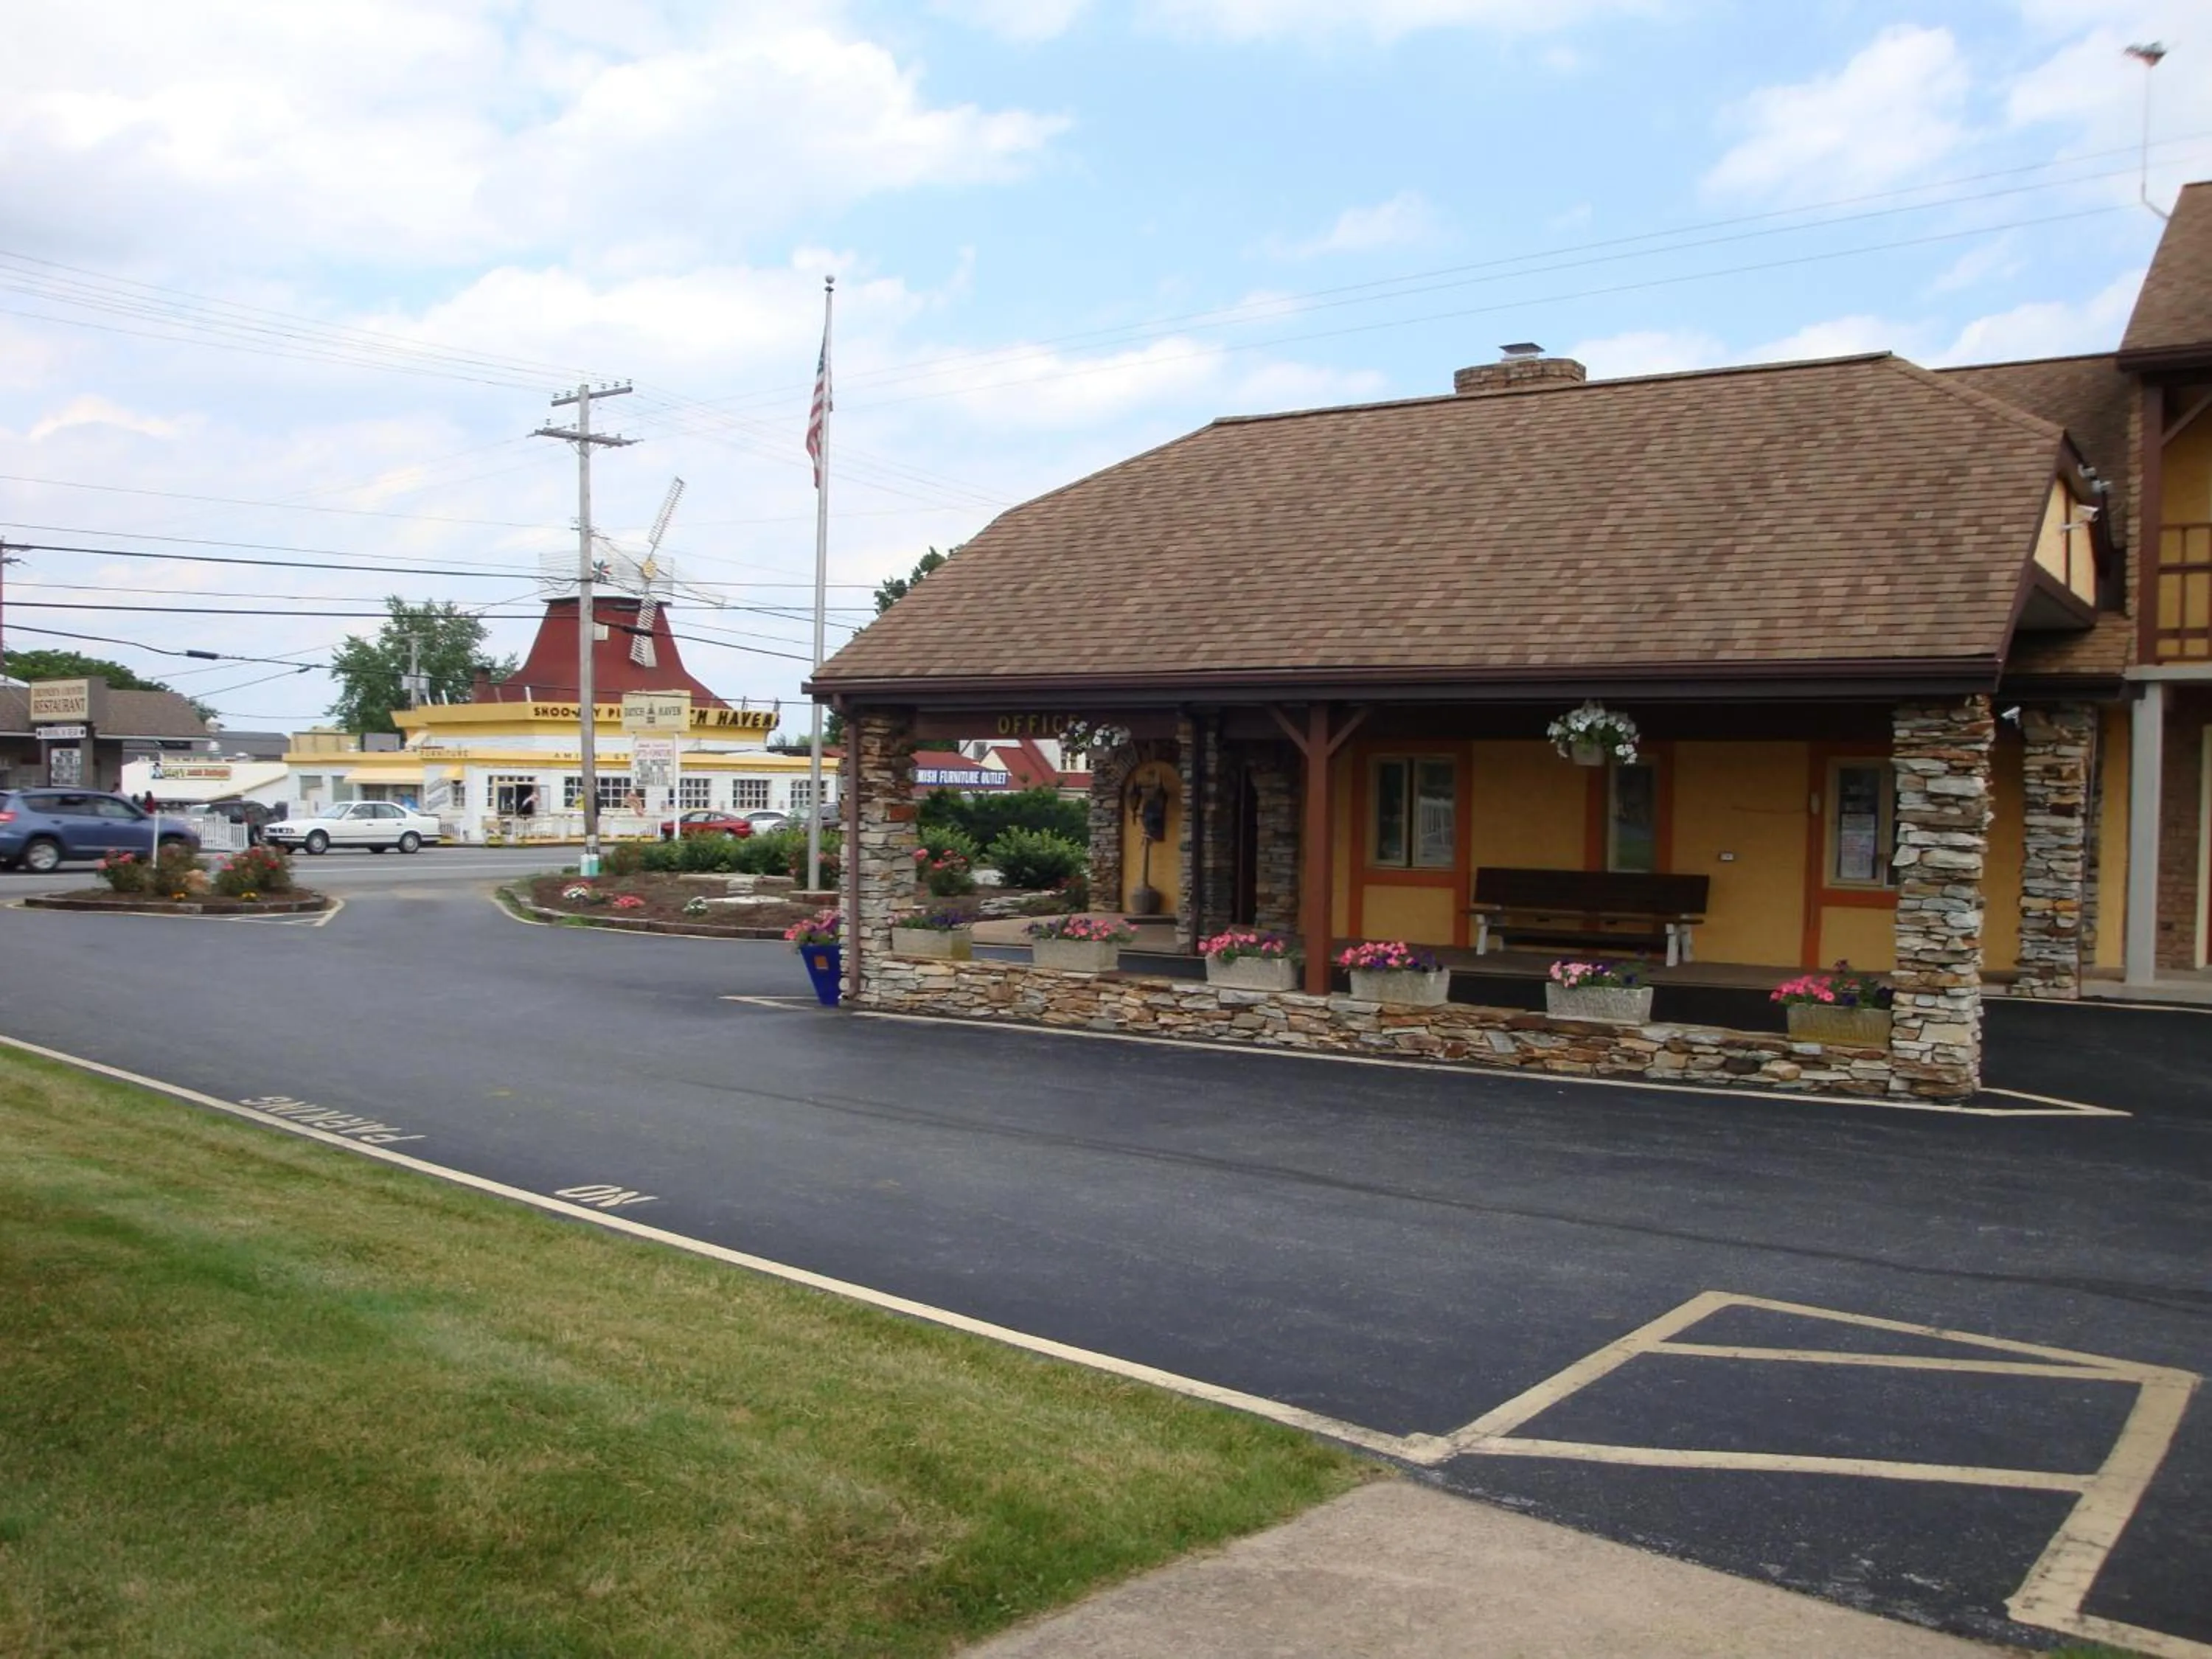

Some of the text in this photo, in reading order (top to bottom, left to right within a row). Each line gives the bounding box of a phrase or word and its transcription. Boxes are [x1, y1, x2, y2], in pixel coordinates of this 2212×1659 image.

[34, 699, 86, 714] RESTAURANT
[658, 706, 682, 716] HAVEN
[717, 709, 773, 727] HAVEN
[554, 752, 601, 762] AMIH
[939, 771, 979, 784] FURNITURE
[981, 772, 1006, 785] OUTLET
[239, 1096, 658, 1207] NO PARKING
